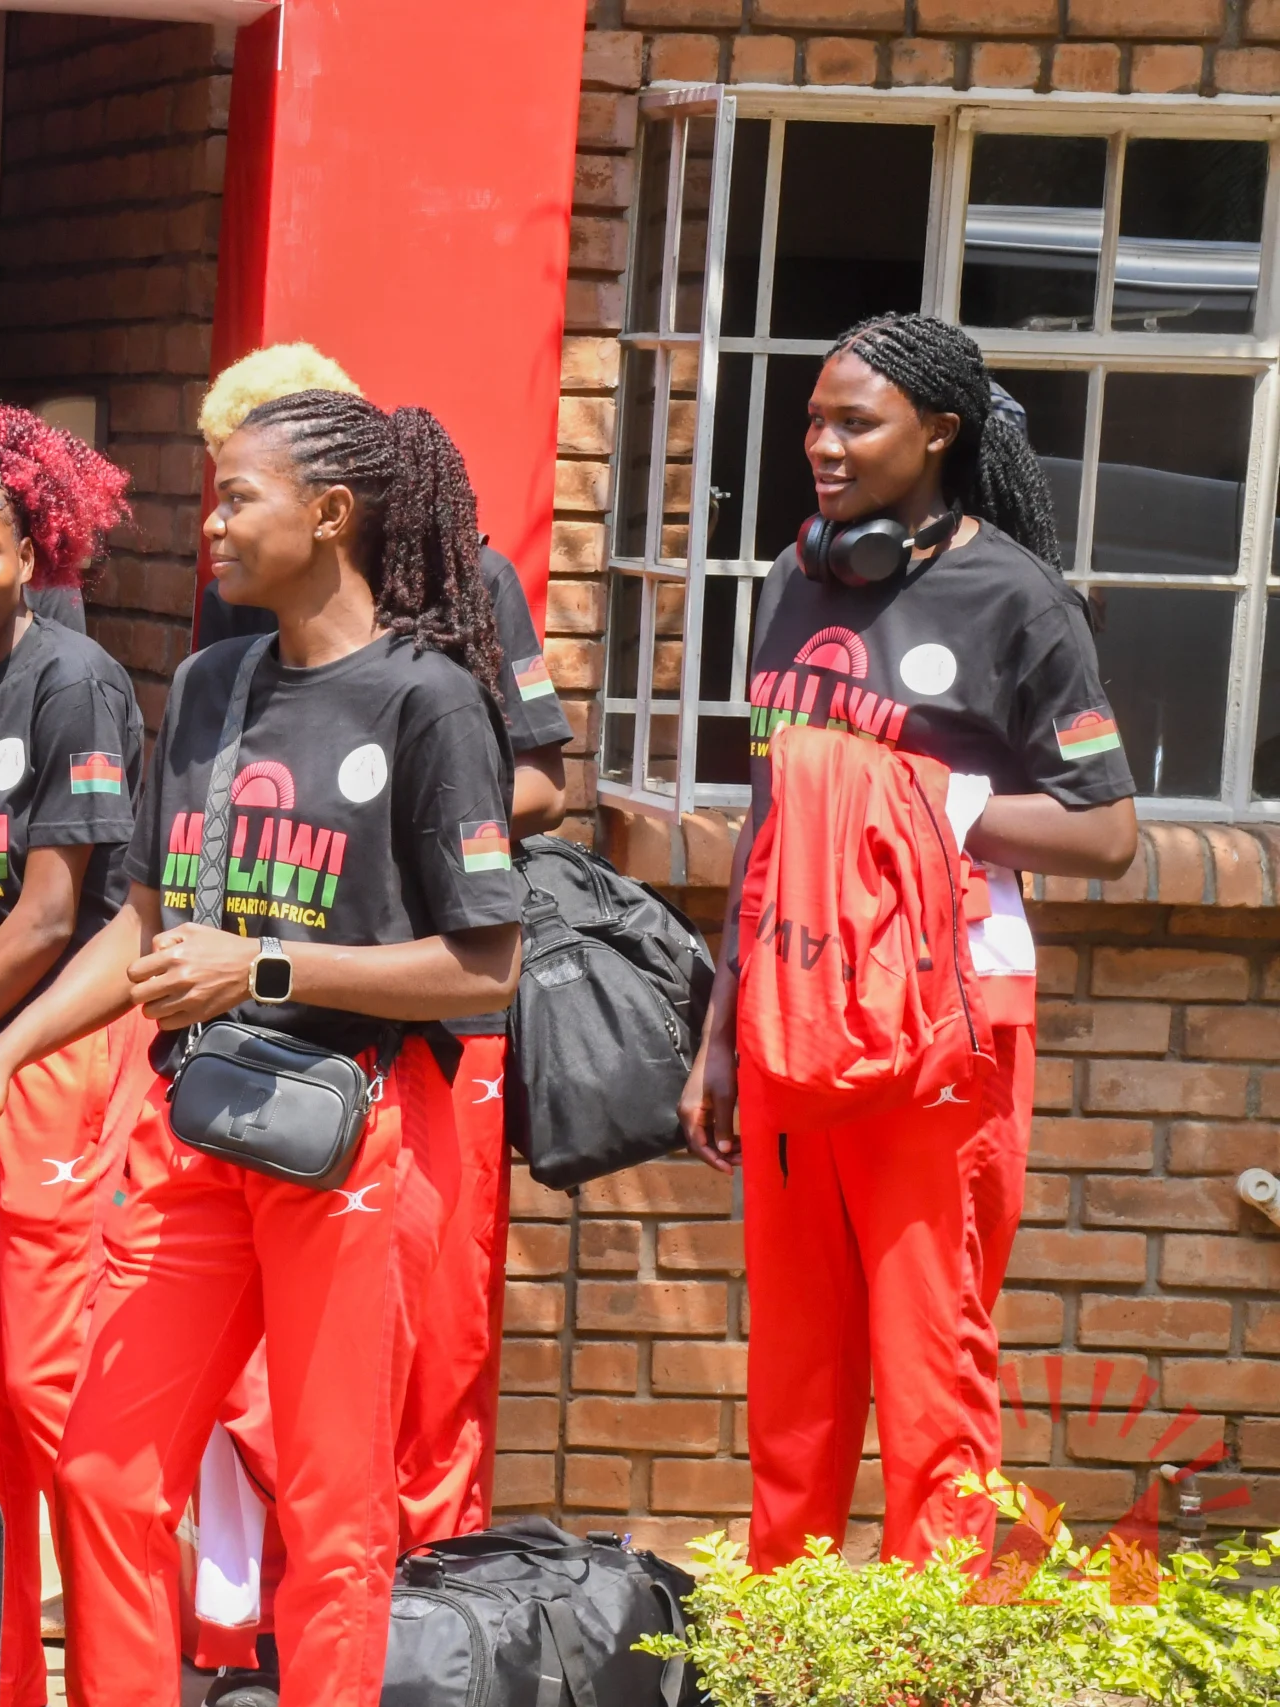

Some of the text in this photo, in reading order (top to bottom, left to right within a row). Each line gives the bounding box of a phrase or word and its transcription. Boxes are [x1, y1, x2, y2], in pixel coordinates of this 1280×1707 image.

[161, 813, 347, 909] MLAWI
[164, 891, 187, 908] THE
[227, 896, 259, 914] HEART
[269, 902, 326, 929] AFRICA
